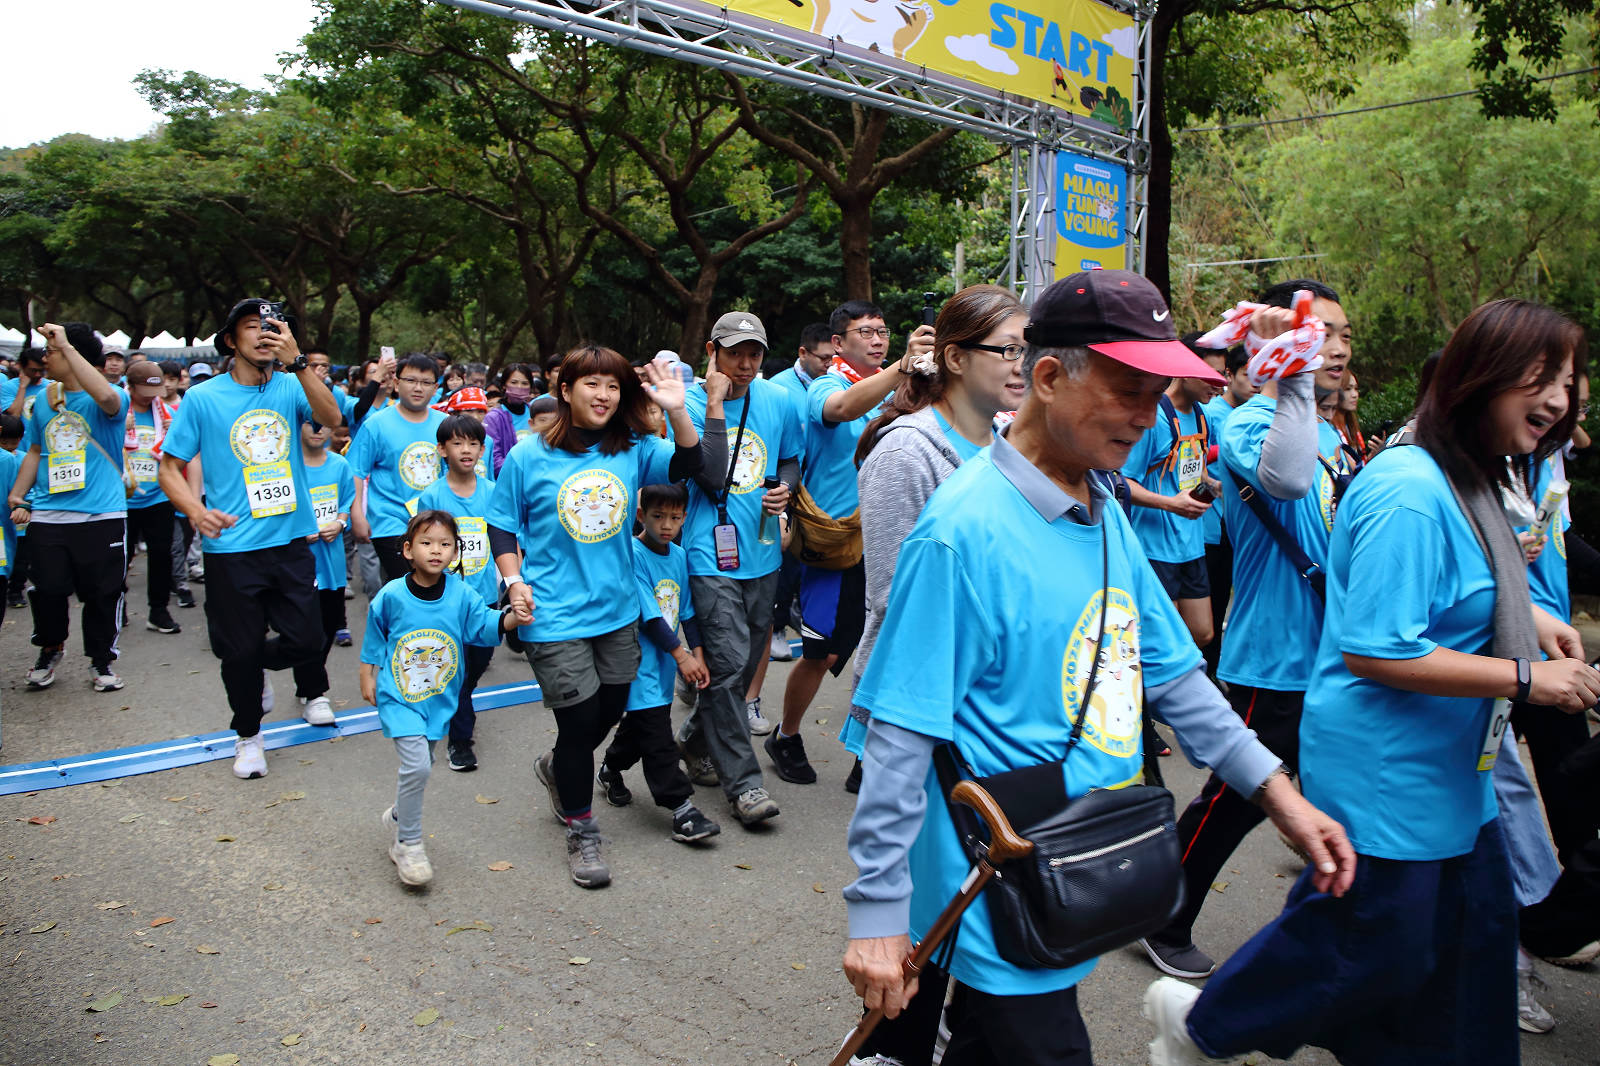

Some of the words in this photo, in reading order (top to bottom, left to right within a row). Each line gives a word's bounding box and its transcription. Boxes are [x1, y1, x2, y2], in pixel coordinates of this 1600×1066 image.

[990, 2, 1113, 84] START
[1063, 172, 1119, 202] MIAOLI
[1067, 193, 1097, 215] FUN
[1063, 210, 1119, 239] YOUNG
[52, 468, 81, 481] 1310
[592, 471, 610, 479] FUN
[1182, 461, 1201, 474] 0581
[254, 485, 291, 501] 1330
[401, 631, 431, 646] MIAOLI
[432, 631, 448, 642] FUN
[447, 640, 457, 665] YOUNG
